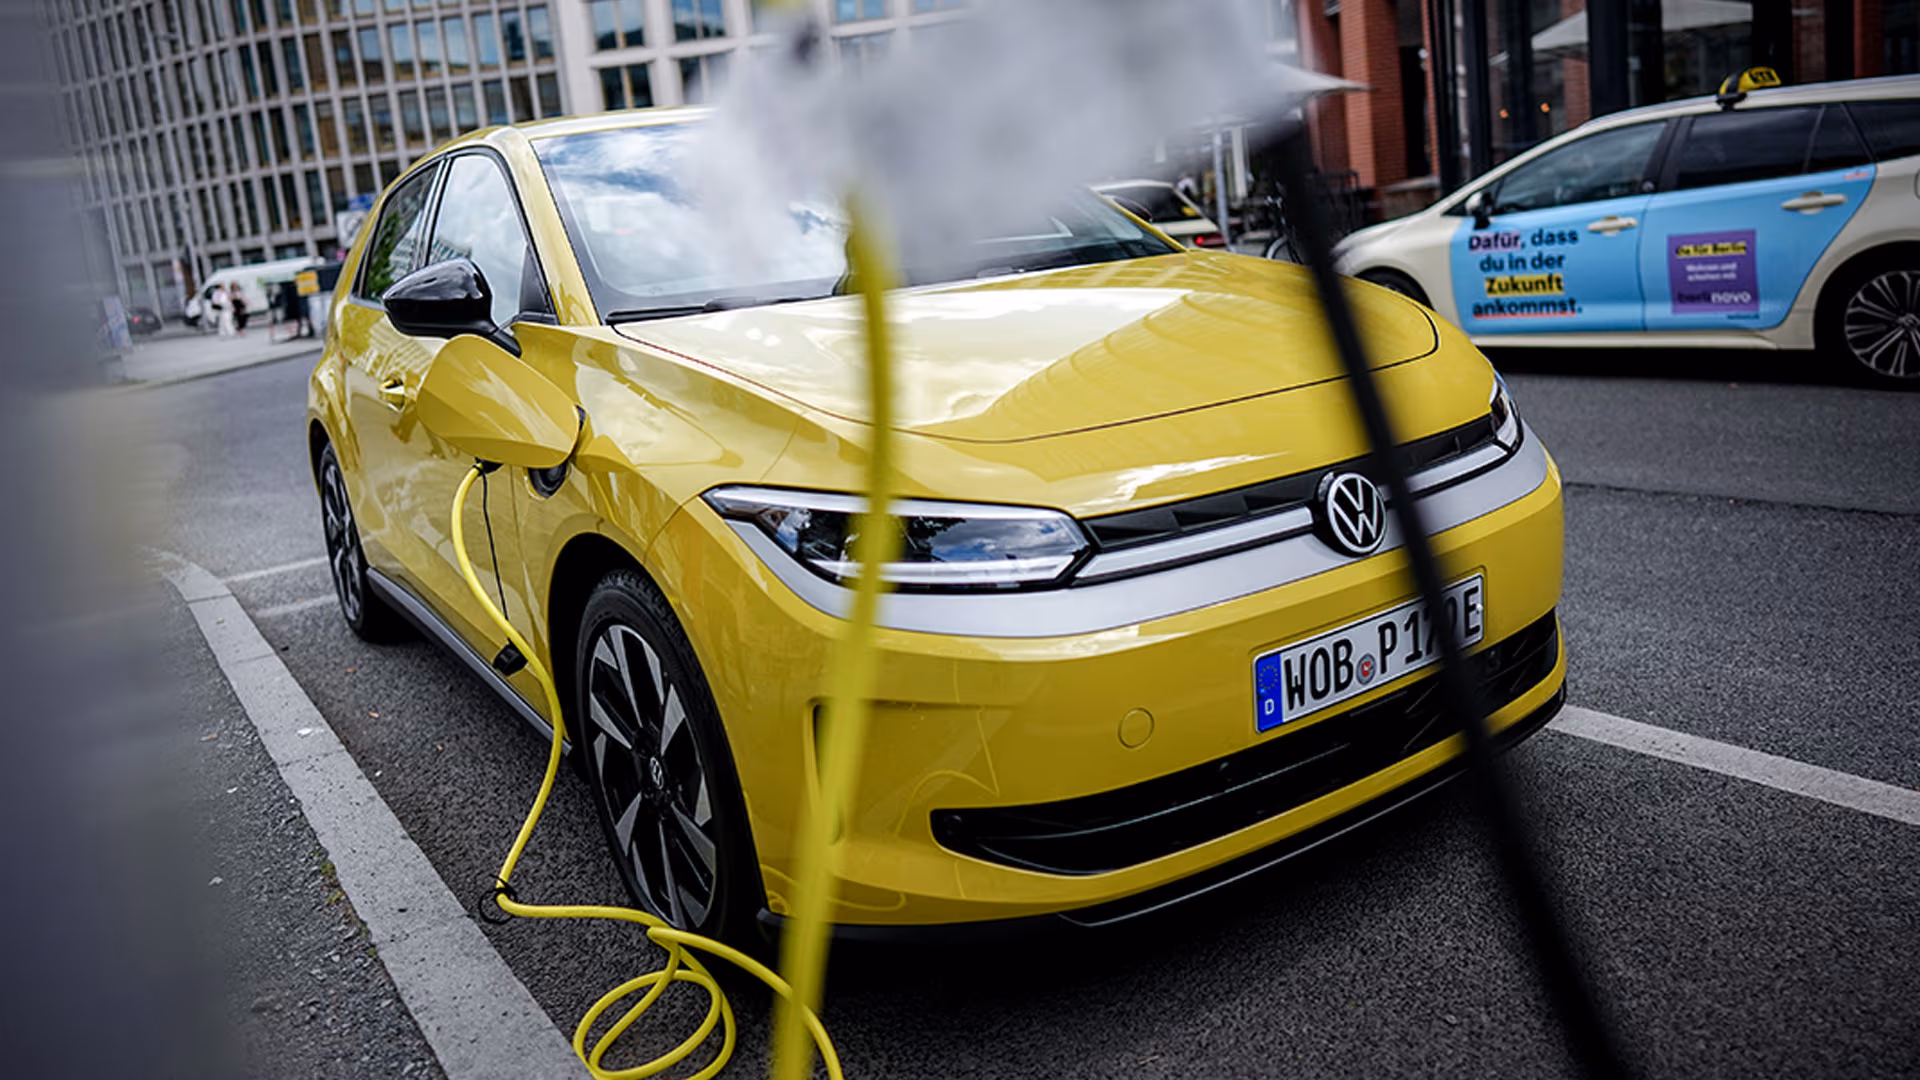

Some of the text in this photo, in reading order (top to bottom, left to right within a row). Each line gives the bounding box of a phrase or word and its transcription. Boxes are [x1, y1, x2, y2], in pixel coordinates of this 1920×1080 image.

[1469, 228, 1578, 250] Dafür, dass
[1480, 251, 1565, 271] du in der
[1486, 273, 1563, 294] Zukunft
[1473, 297, 1583, 316] ankommst.
[1284, 638, 1353, 711] WOB
[1265, 698, 1275, 716] D
